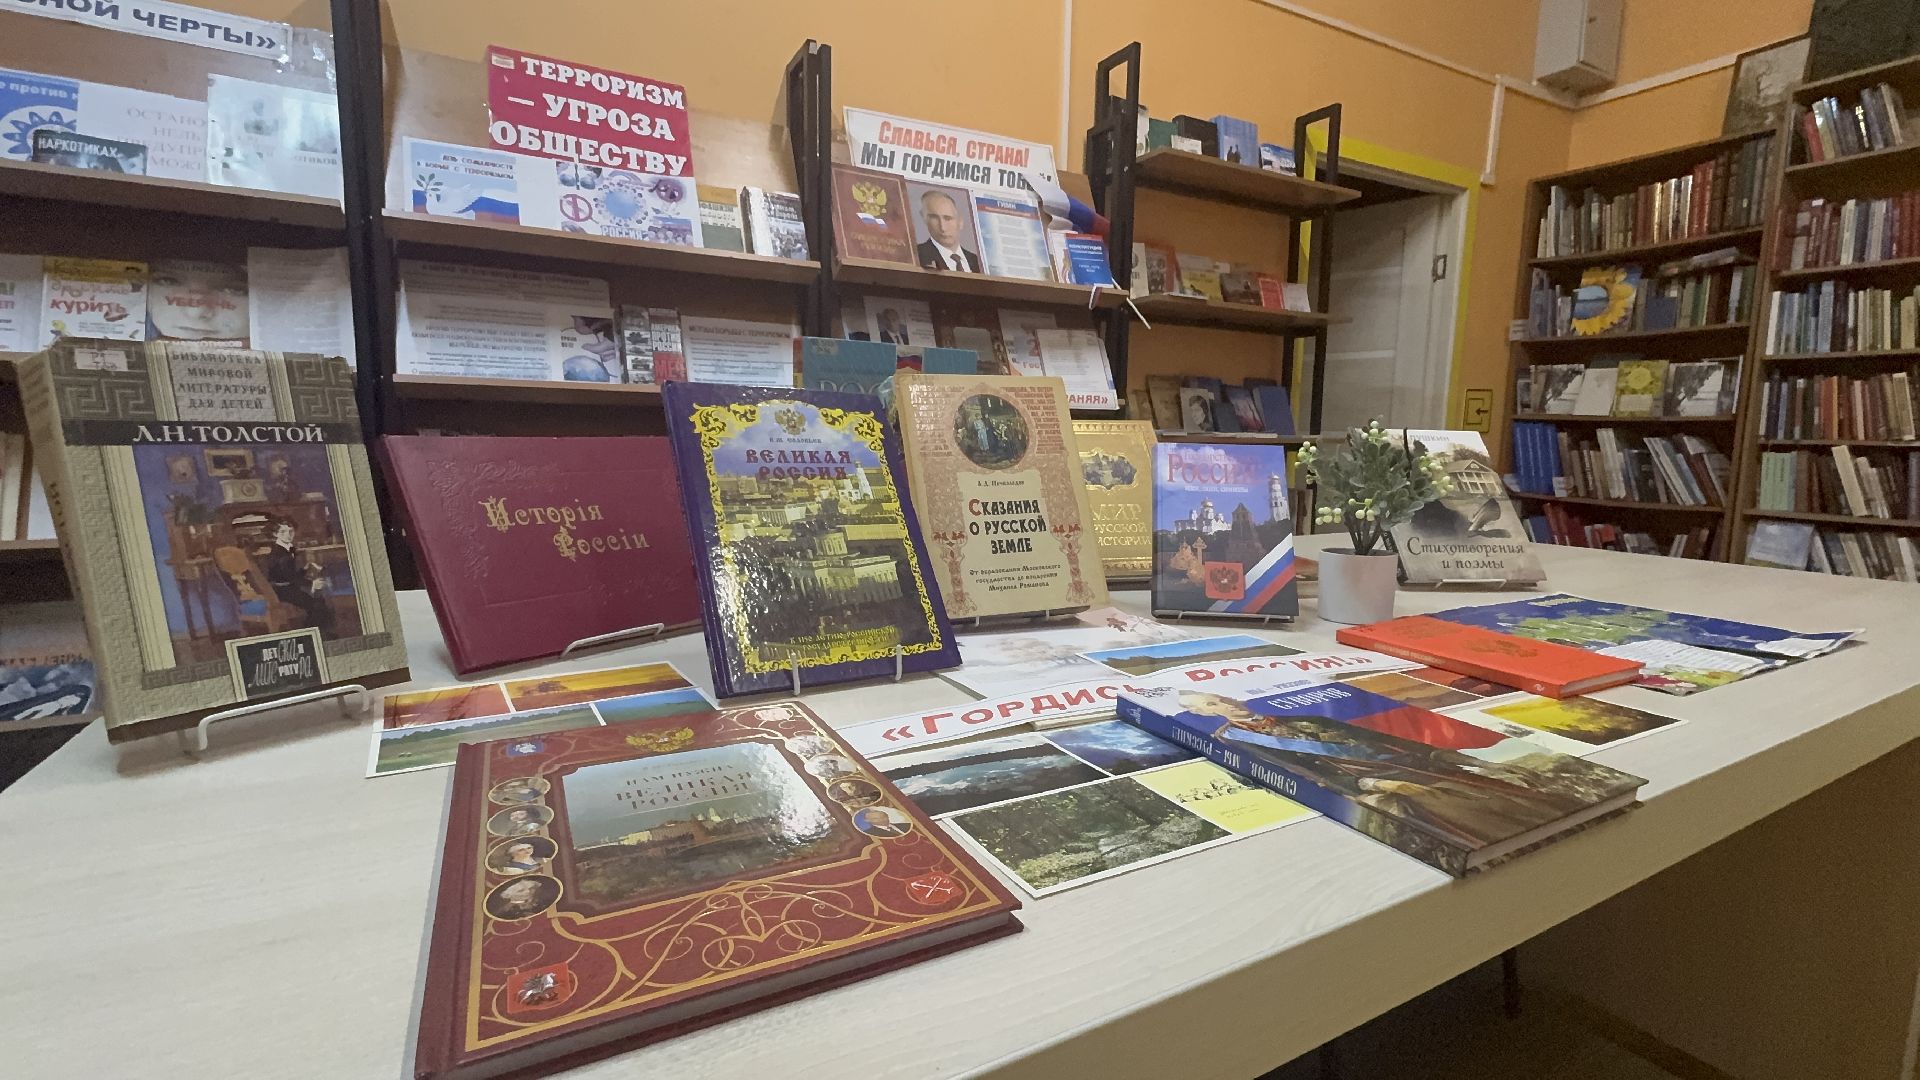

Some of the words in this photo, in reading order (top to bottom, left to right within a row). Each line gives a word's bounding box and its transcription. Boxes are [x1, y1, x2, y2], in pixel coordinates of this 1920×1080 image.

[133, 9, 275, 49] ЧЕРТЫ»
[521, 56, 684, 109] ТЕРРОРИЗМ
[542, 93, 675, 141] УГРОЗА
[38, 137, 118, 157] НАРКОТИКАХ
[490, 121, 687, 176] ОБЩЕСТВУ
[966, 140, 1029, 168] СТРАНА!
[902, 152, 991, 185] ГОРДИМСЯ
[745, 449, 852, 464] ВЕЛИКАЯ
[757, 466, 850, 480] РОССИЯ
[968, 498, 1040, 517] СКАЗАНИЯ
[969, 521, 980, 536] О
[984, 515, 1047, 536] РУССКОЙ
[990, 538, 1033, 555] ЗЕМЛЕ
[1406, 536, 1524, 558] Стихотворения
[1455, 559, 1504, 569] поэмы
